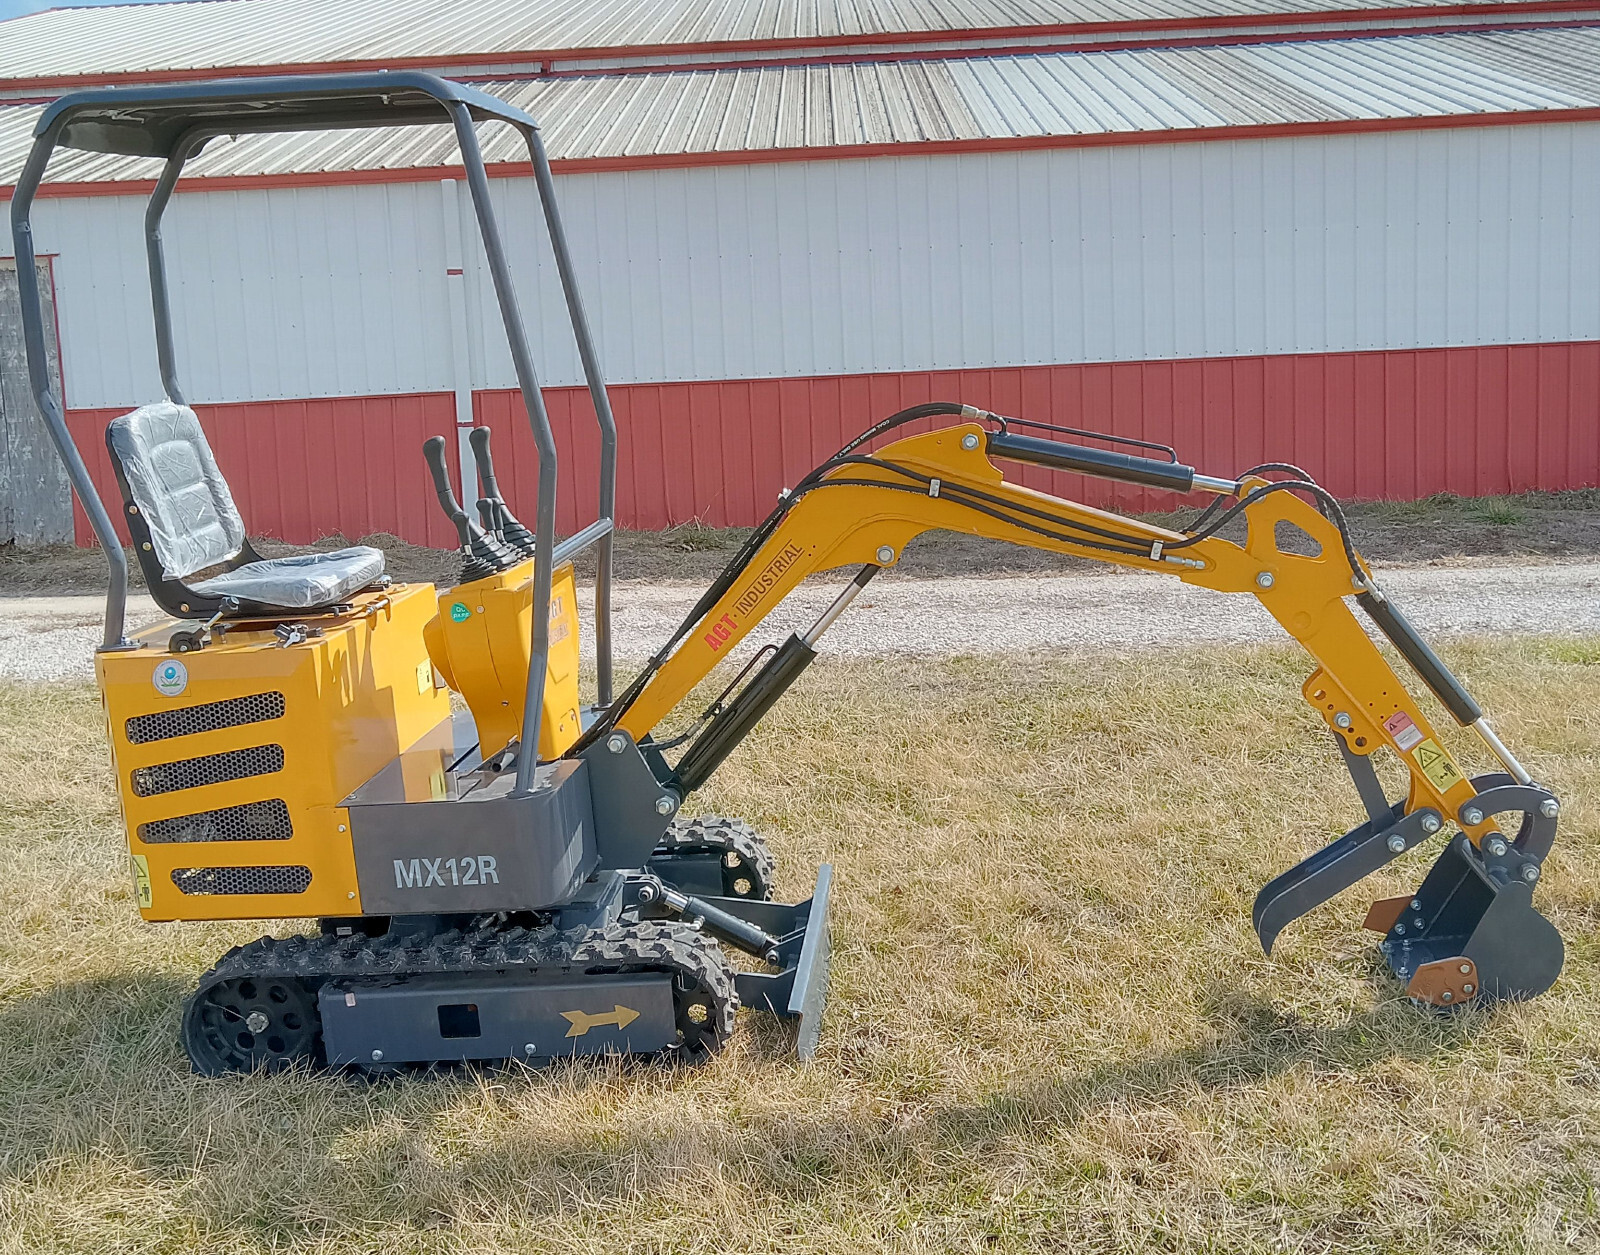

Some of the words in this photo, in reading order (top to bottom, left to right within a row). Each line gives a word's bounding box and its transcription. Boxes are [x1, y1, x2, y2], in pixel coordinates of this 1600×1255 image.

[704, 612, 738, 652] AGT
[736, 544, 803, 616] INDUSTRIAL
[393, 854, 500, 889] MX12R
